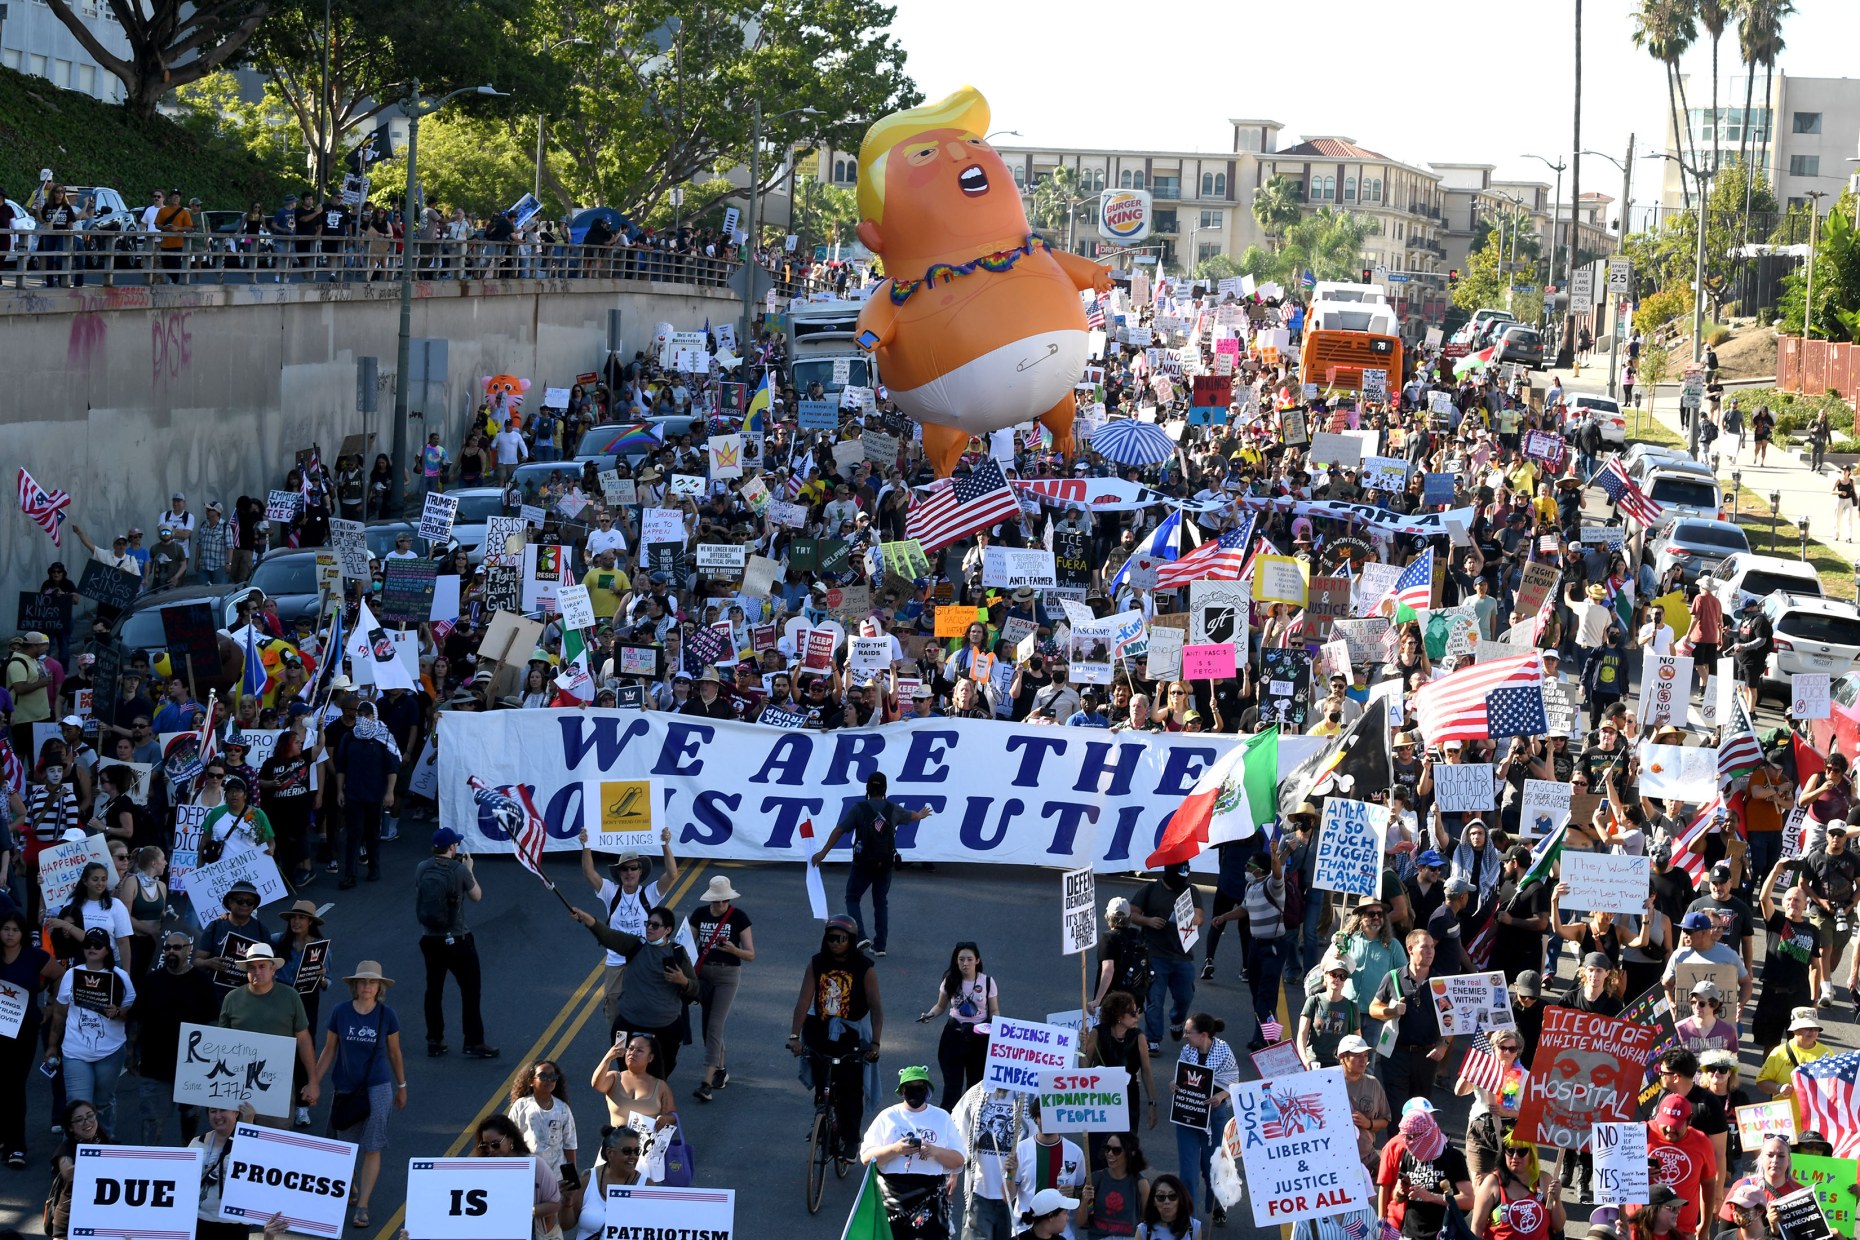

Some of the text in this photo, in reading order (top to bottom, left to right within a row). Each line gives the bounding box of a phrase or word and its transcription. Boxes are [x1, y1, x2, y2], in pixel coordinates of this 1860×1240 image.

[1106, 199, 1142, 214] BURGER
[1107, 209, 1143, 227] KING
[1100, 247, 1121, 255] DRIVE
[1611, 274, 1627, 283] 25
[1377, 342, 1386, 350] 78
[1167, 352, 1181, 362] NO
[720, 407, 741, 415] RESIST
[607, 481, 631, 490] PROTEST
[427, 494, 452, 507] TRUMP
[267, 509, 283, 519] ICE
[490, 517, 526, 532] RESIST
[1060, 533, 1082, 546] ICE
[659, 556, 674, 564] THEN
[795, 545, 850, 569] TRY HELPING
[1056, 556, 1087, 572] FUERA
[101, 567, 123, 583] NO
[486, 568, 516, 582] Fight
[1532, 566, 1556, 578] FIGHT
[487, 582, 517, 595] Like A
[1309, 579, 1350, 591] LIBERTY
[486, 594, 516, 612] Girl!
[844, 596, 865, 607] great
[1321, 591, 1330, 603] &
[26, 606, 60, 617] KINGS
[700, 625, 722, 642] MAKE
[1073, 626, 1110, 636] FASCISM?
[1150, 627, 1184, 640] FEELING
[690, 635, 719, 658] FICTION
[696, 632, 722, 652] ORWELL
[809, 634, 833, 645] KEEP
[852, 640, 888, 649] STOP THE
[686, 644, 712, 663] AGAIN
[808, 644, 831, 652] FAMILIES
[1123, 640, 1149, 656] WAY
[1659, 657, 1675, 665] NO
[1658, 682, 1672, 690] NO
[1795, 675, 1828, 686] FASCISTS
[1799, 687, 1824, 698] FUCK
[1656, 703, 1670, 711] NO
[766, 708, 804, 724] TRUMP
[557, 715, 1218, 796] WE ARE THE
[273, 765, 285, 774] NO
[1439, 765, 1488, 781] NO KINGS
[415, 772, 436, 791] Only
[1437, 780, 1491, 796] NO DICTATORS
[273, 786, 308, 798] AMERICA
[1440, 795, 1490, 810] NO NAZIS
[1532, 799, 1568, 810] ORANGE
[1326, 818, 1365, 834] IS SO
[600, 833, 653, 846] NO KINGS
[1323, 831, 1375, 850] MUCH
[56, 841, 90, 858] WHAT
[1319, 843, 1379, 864] BIGGER
[40, 854, 87, 874] HAPPENED
[192, 850, 259, 884] IMMIGRANTS
[1318, 857, 1357, 872] THAN
[1572, 856, 1601, 873] They
[211, 866, 248, 886] ARE NOT
[1316, 869, 1377, 889] FLAWED
[1333, 880, 1373, 897] MAN
[1599, 888, 1616, 898] Let
[620, 906, 640, 917] TAX
[1066, 910, 1090, 928] IT'S TIME
[620, 918, 640, 928] THE
[1070, 922, 1095, 940] A GENERAL
[1453, 977, 1482, 988] the real
[1545, 1009, 1652, 1044] ICE OUT OF
[184, 1030, 258, 1063] Rejecting
[1057, 1033, 1070, 1047] DE
[1541, 1033, 1652, 1067] WHITE MEMORIAL
[204, 1059, 277, 1092] Mad Kings
[1053, 1076, 1100, 1090] STOP
[183, 1081, 252, 1101] Since 1776
[1531, 1073, 1631, 1120] HOSPITAL
[1041, 1092, 1122, 1107] KIDNAPPING
[1056, 1109, 1107, 1123] PEOPLE
[1753, 1105, 1774, 1119] NO
[1597, 1125, 1619, 1149] NO
[1267, 1137, 1331, 1161] LIBERTY
[1655, 1150, 1686, 1162] CENTRO
[1297, 1160, 1309, 1172] &
[230, 1161, 347, 1198] PROCESS
[1274, 1173, 1339, 1194] JUSTICE
[1595, 1168, 1620, 1192] YES
[1811, 1170, 1836, 1184] MY
[93, 1177, 176, 1208] DUE
[448, 1189, 488, 1216] IS
[1267, 1195, 1309, 1217] FOR
[1512, 1203, 1537, 1212] CENTRO
[1786, 1195, 1812, 1210] KINGS.
[1782, 1204, 1817, 1221] NO TRUMP
[1782, 1213, 1822, 1230] TAKEOVER.
[606, 1225, 730, 1240] PATRIOTISM
